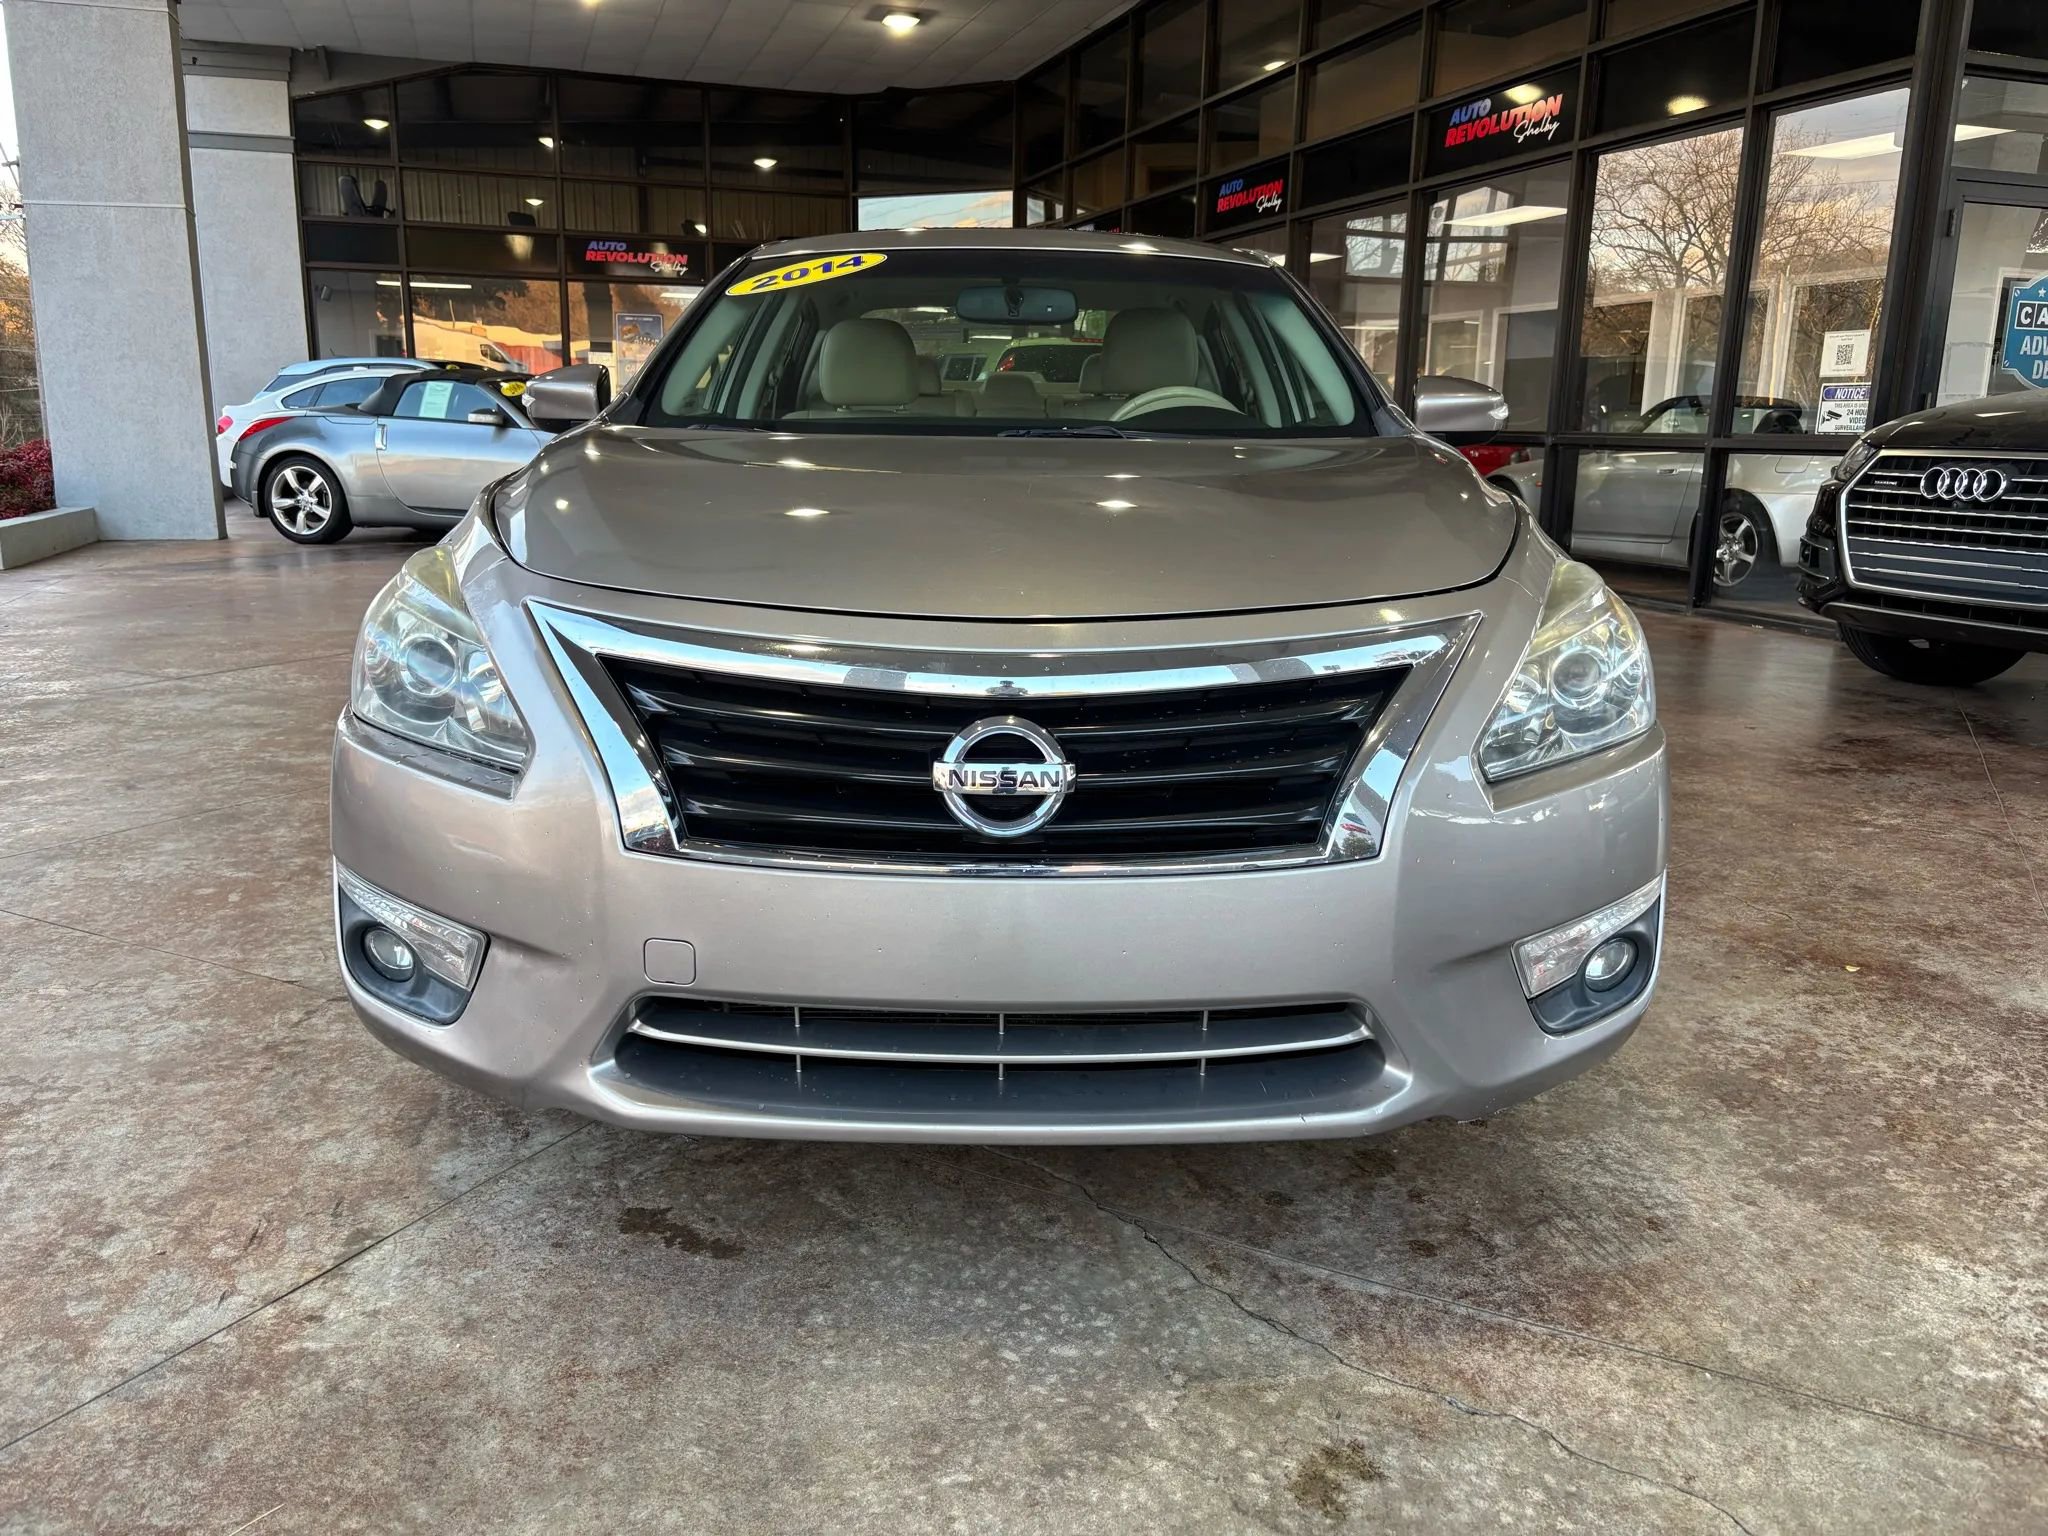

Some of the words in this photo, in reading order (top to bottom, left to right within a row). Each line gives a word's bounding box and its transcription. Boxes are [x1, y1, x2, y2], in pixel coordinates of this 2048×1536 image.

[1444, 94, 1563, 148] REVOLUTION
[1449, 98, 1492, 126] AUTO
[1513, 112, 1560, 143] Shelby
[1216, 179, 1283, 213] REVOLUTION
[1219, 179, 1243, 197] AUTO
[1256, 191, 1282, 213] Shelby
[588, 241, 626, 251] AUTO
[585, 251, 688, 265] REVOLUTION
[750, 255, 867, 291] 2014
[1834, 388, 1866, 399] NOTICE
[948, 769, 1060, 788] NISSAN
